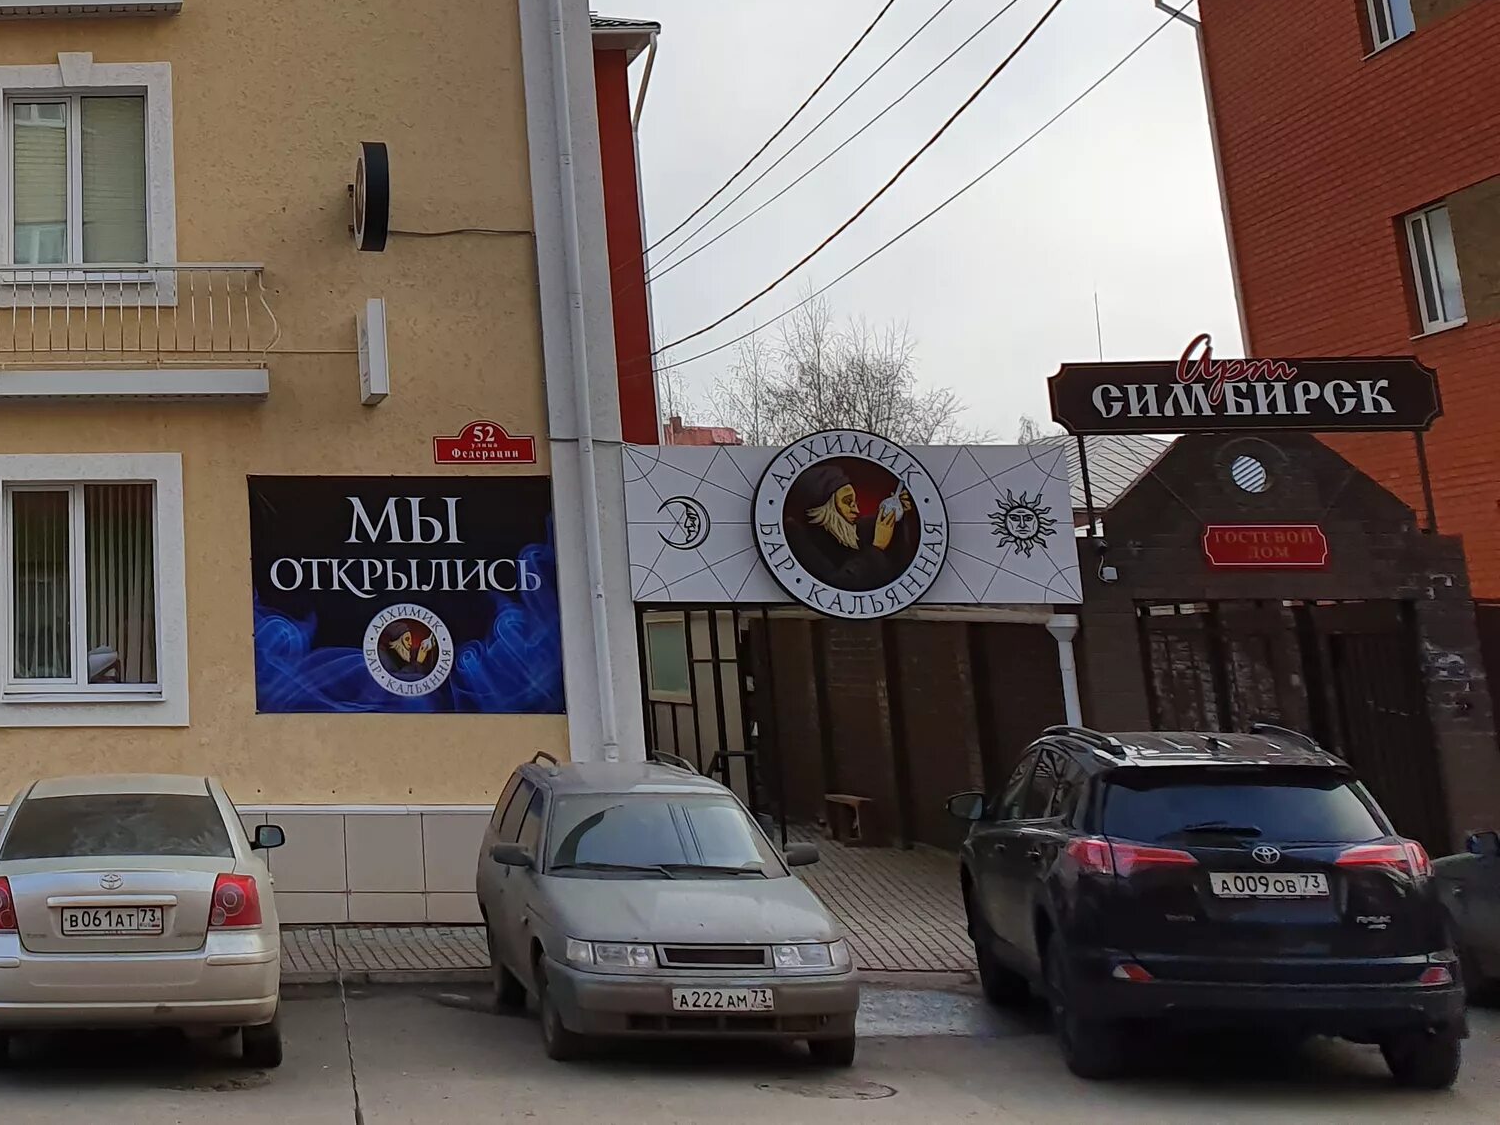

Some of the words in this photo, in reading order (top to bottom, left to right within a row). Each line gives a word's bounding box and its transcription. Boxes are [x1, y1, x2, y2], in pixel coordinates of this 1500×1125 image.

[1176, 333, 1298, 405] Арт
[1092, 379, 1396, 418] СИМБИРСК
[451, 448, 519, 460] Федерации
[473, 426, 495, 442] 52
[770, 434, 923, 491] АЛХИМИК
[344, 496, 465, 544] МЫ
[270, 558, 542, 598] ОТКРЫЛИСЬ
[759, 522, 796, 572] БАР
[806, 521, 943, 615] КАЛЬЯННАЯ
[372, 606, 443, 634] АЛХИМИК
[366, 648, 382, 674] БАР
[386, 649, 452, 695] КАЛЬЯННАЯ
